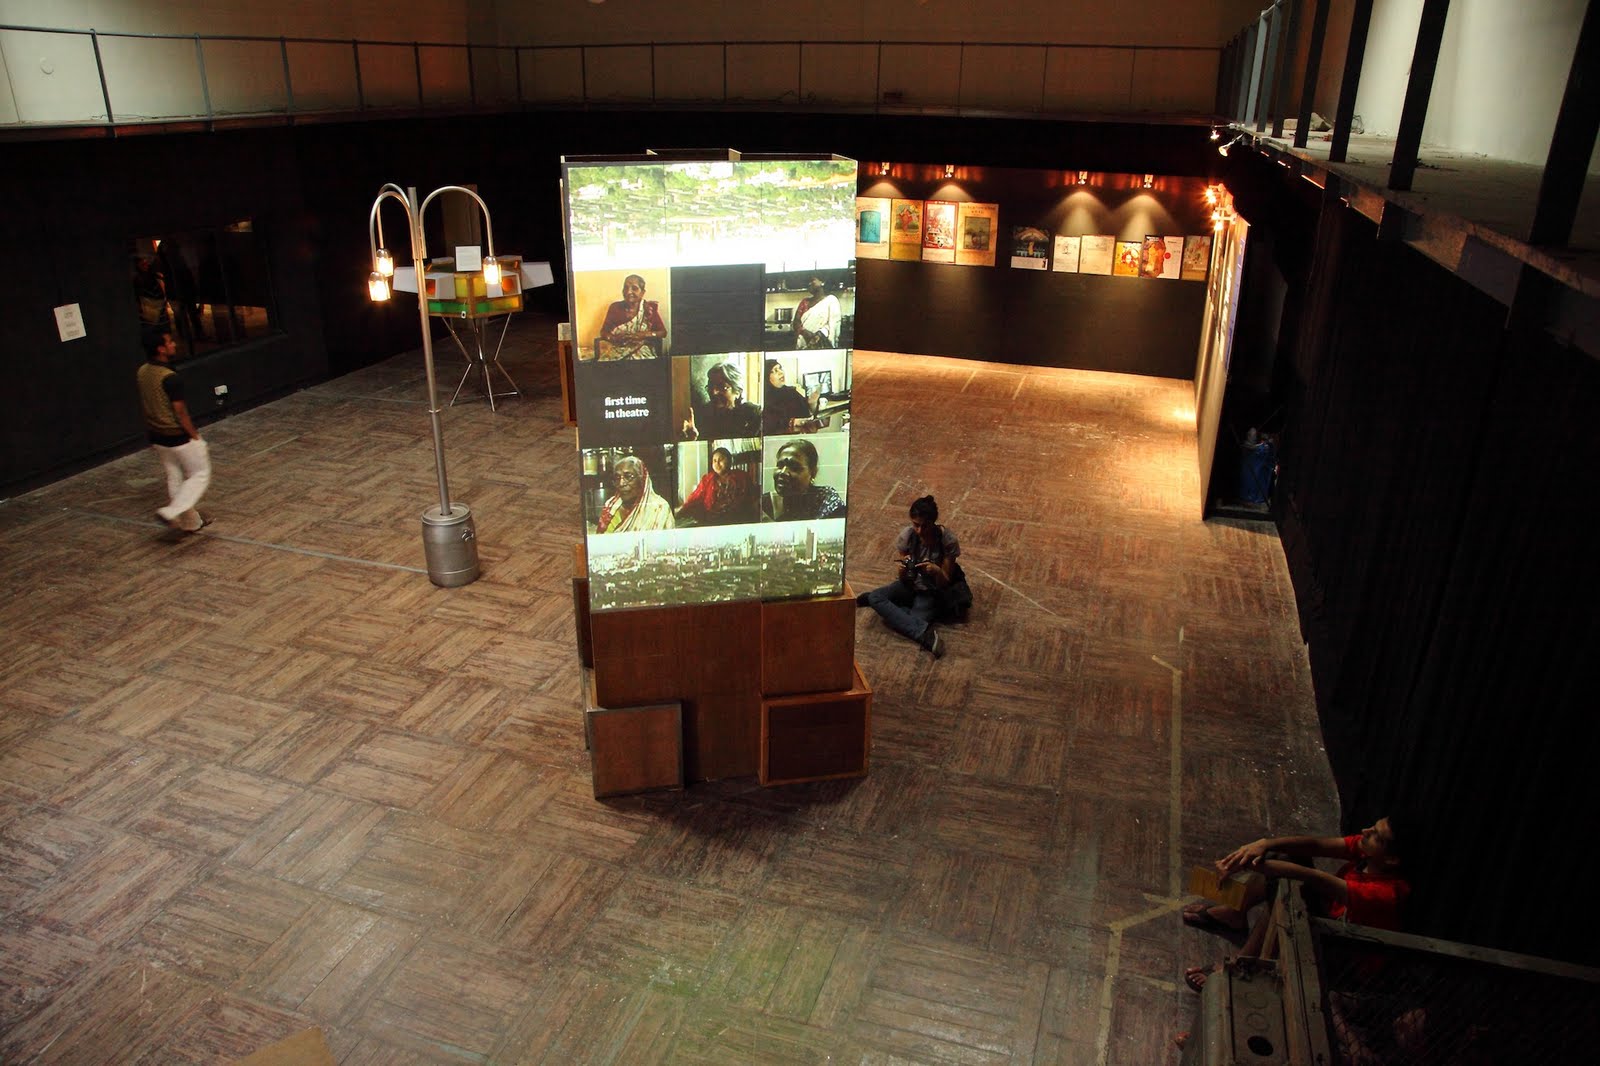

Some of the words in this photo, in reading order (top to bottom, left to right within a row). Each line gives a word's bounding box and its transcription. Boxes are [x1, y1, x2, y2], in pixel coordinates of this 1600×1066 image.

[604, 396, 624, 406] first
[625, 395, 647, 405] time
[605, 409, 615, 419] in
[615, 408, 650, 418] theatre
